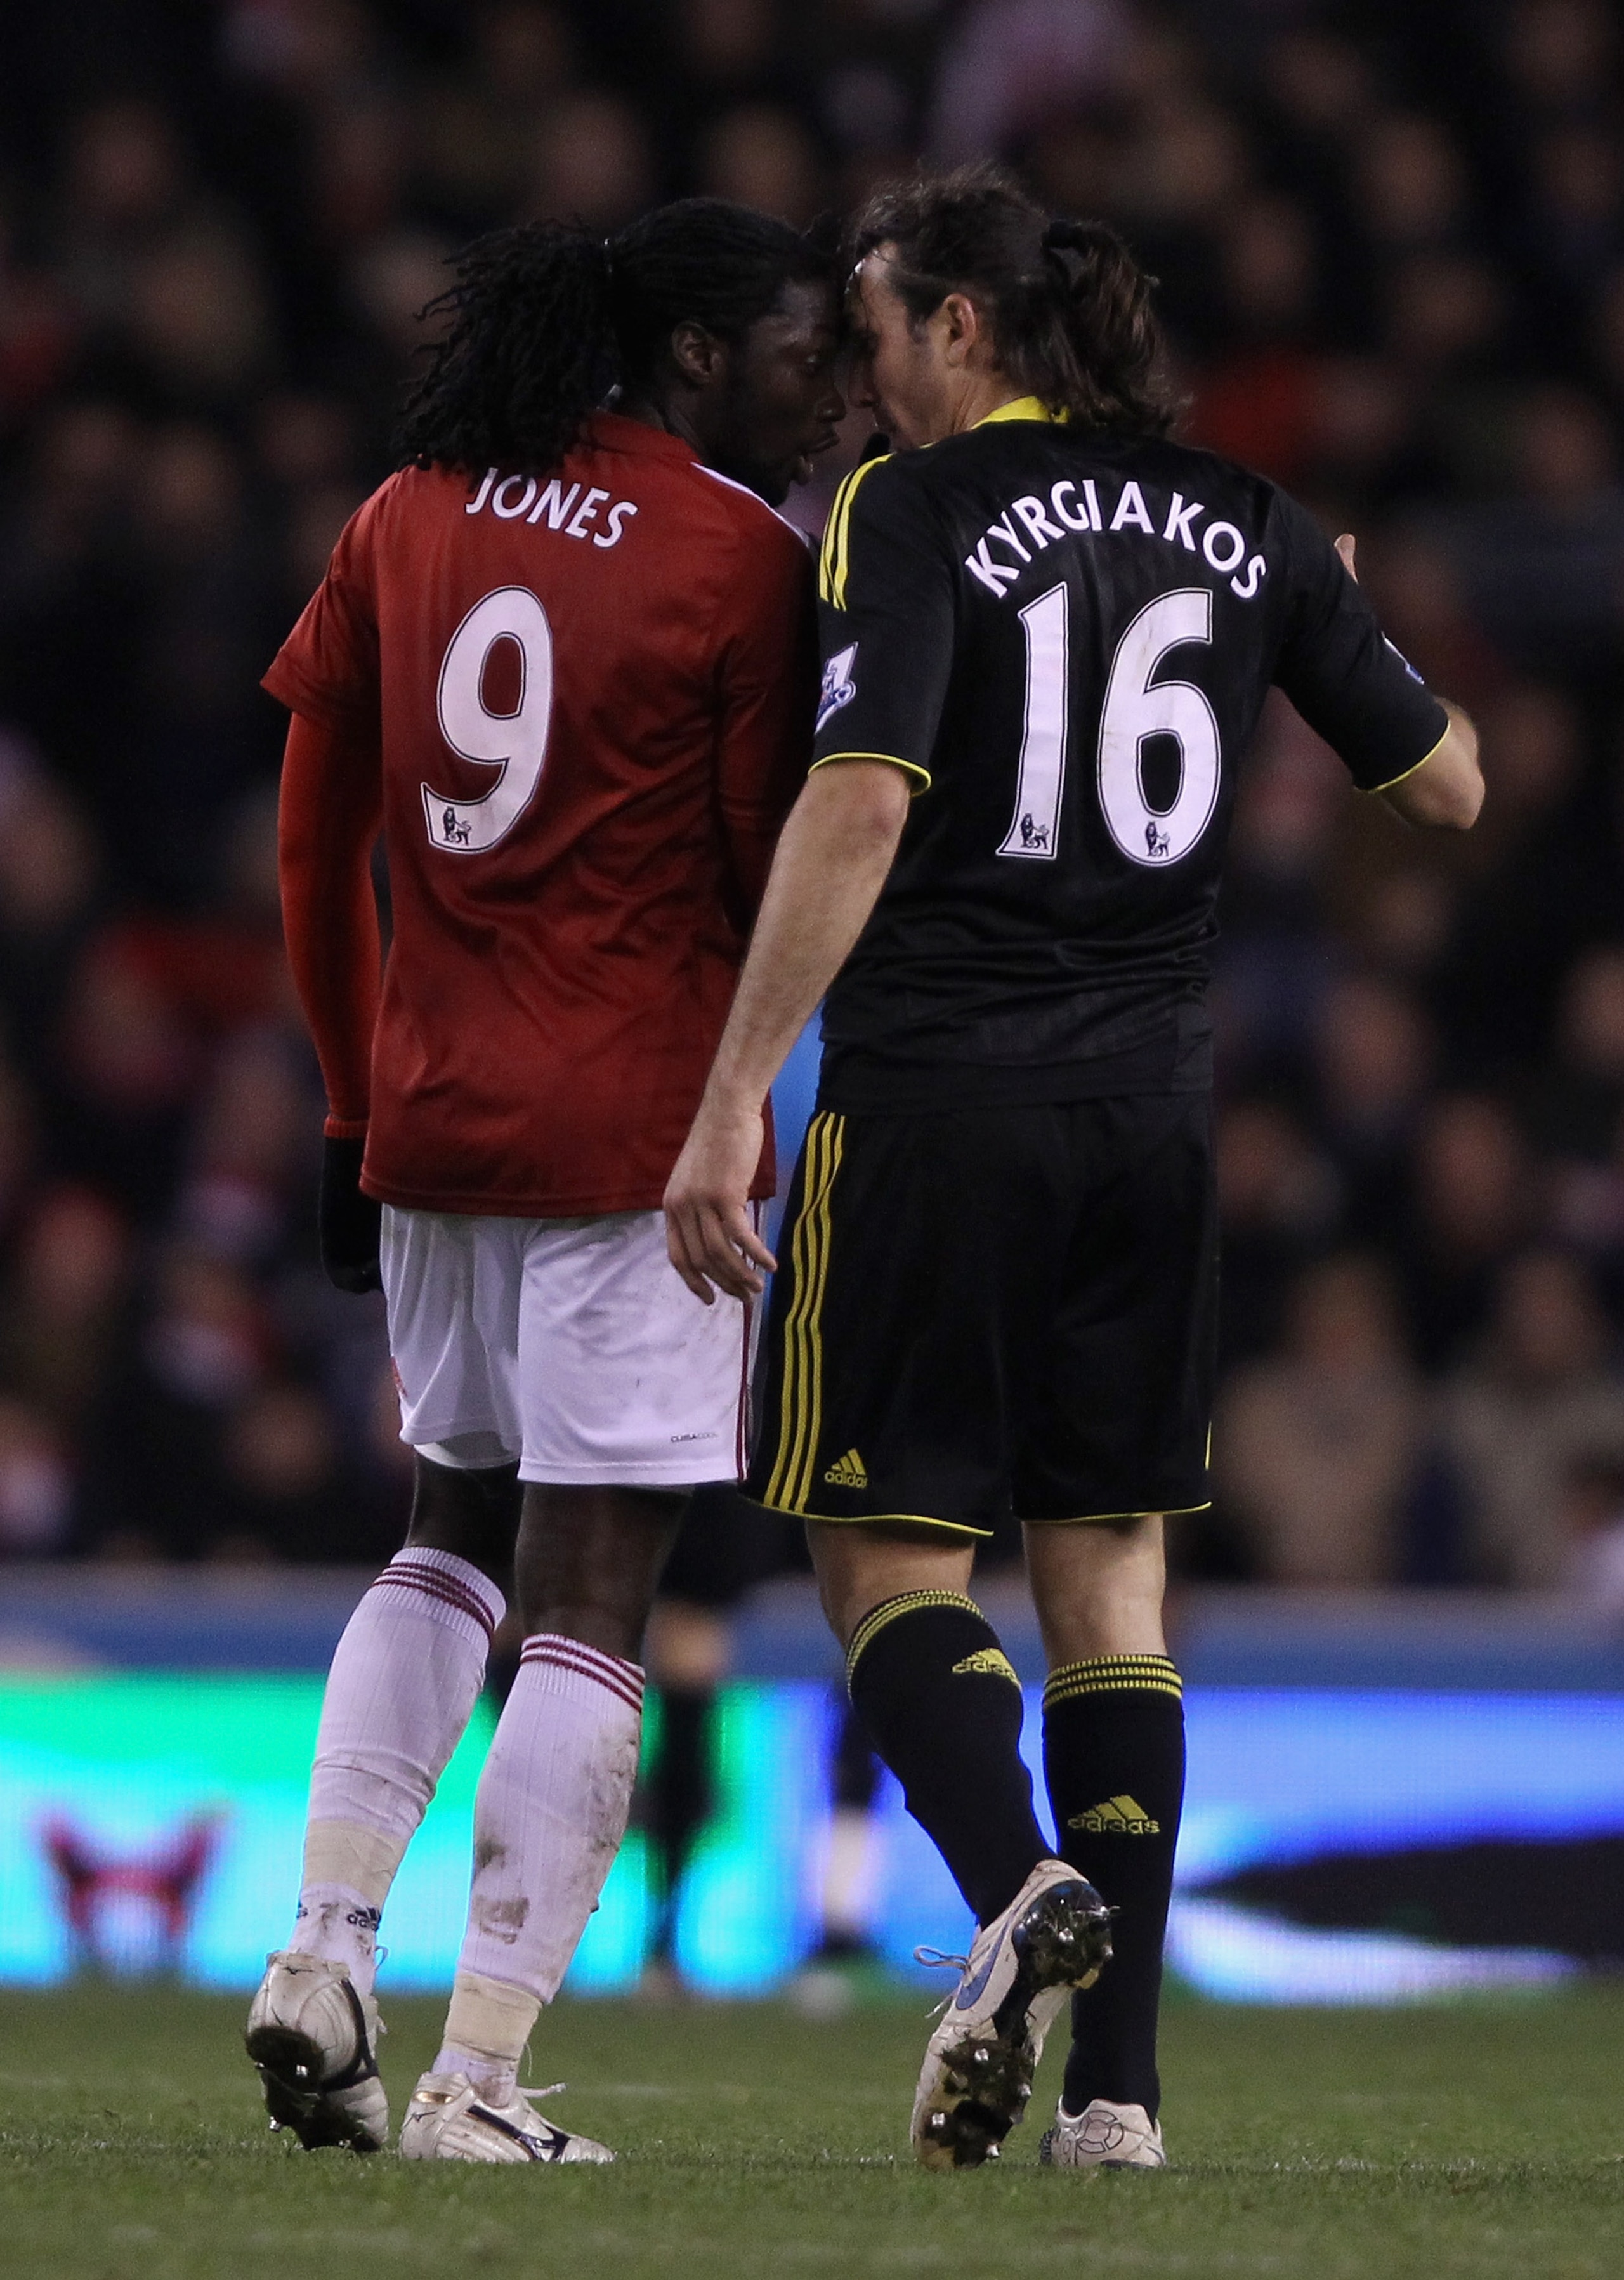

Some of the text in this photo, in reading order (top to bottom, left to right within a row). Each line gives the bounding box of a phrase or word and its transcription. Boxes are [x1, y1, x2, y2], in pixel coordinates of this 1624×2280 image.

[465, 467, 638, 547] JONES
[964, 479, 1266, 599] KYRGIAKOS
[420, 585, 553, 854] 9
[995, 581, 1221, 867] 16
[1067, 1816, 1160, 1835] adidas
